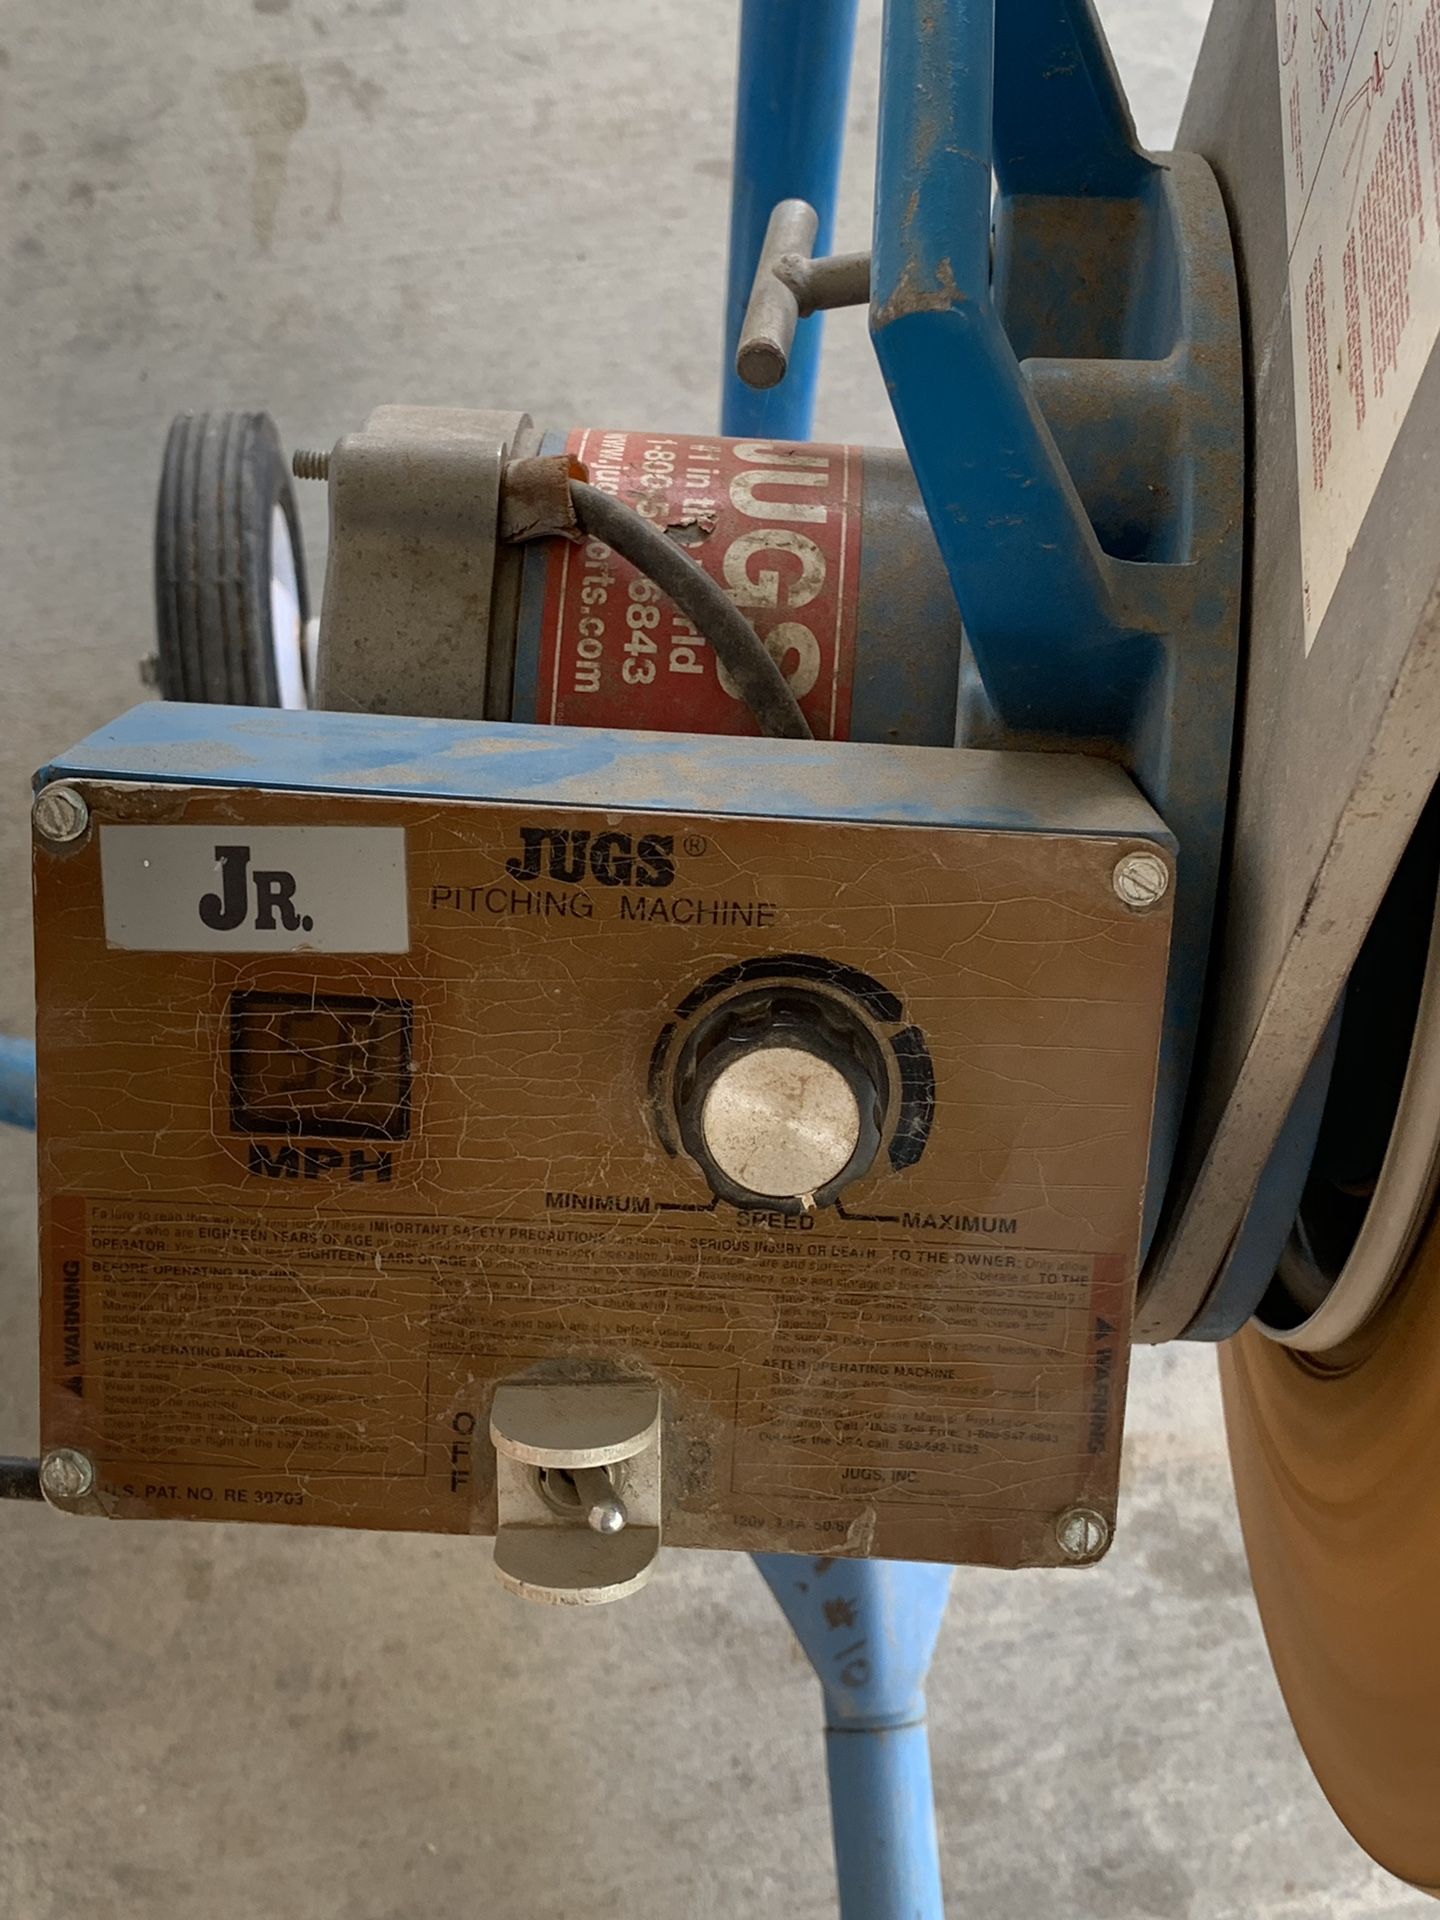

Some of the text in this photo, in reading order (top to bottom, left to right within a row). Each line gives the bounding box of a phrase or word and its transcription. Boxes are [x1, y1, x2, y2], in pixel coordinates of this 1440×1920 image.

[685, 467, 720, 489] in
[506, 827, 675, 888] JUGS
[430, 884, 778, 929] PITCHING MACHINE
[248, 1144, 393, 1184] MPH
[545, 1191, 1018, 1236] MINIMUM SPEED MAXIMUM
[343, 1234, 373, 1249] AGE
[688, 1237, 751, 1254] SERIOUS
[805, 1244, 825, 1258] OR
[891, 1249, 910, 1263] TO
[915, 1250, 948, 1265] THE
[1037, 1272, 1057, 1286] TO
[62, 1260, 81, 1368] WARNING
[140, 1344, 222, 1359] OPERATING
[761, 1358, 806, 1371] AFTER
[811, 1361, 889, 1376] OPERATING
[255, 1439, 274, 1451] the
[144, 1485, 182, 1500] PAT.
[223, 1488, 249, 1503] RE
